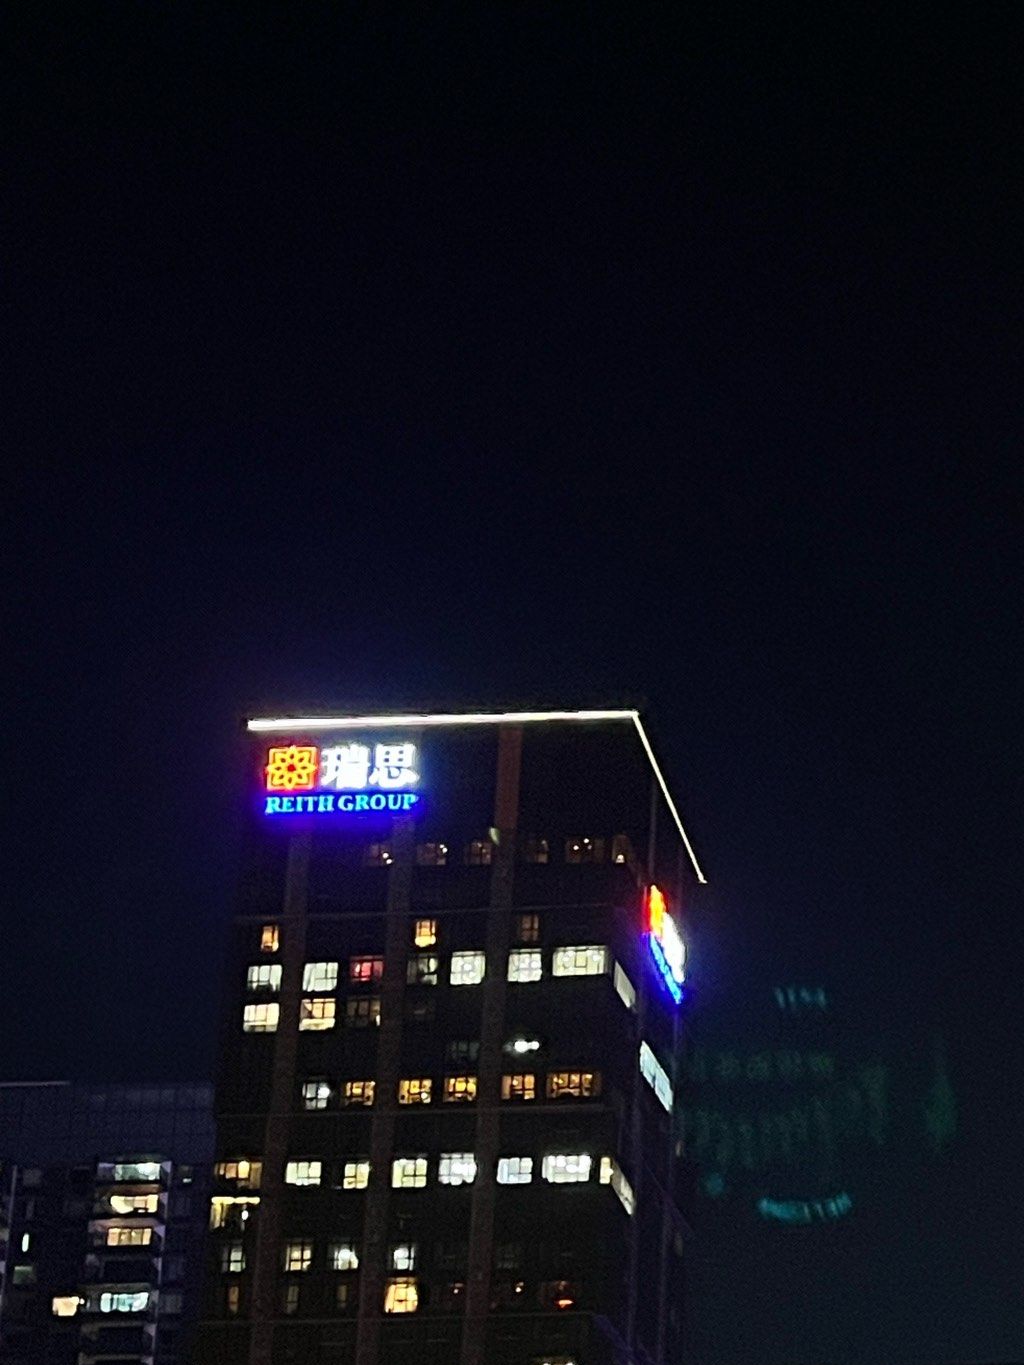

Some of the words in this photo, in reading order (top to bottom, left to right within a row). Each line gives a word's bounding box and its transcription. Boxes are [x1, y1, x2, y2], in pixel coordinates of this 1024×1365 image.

[320, 743, 420, 789] 瑞思
[265, 794, 335, 815] REITH
[338, 793, 419, 812] GROUP
